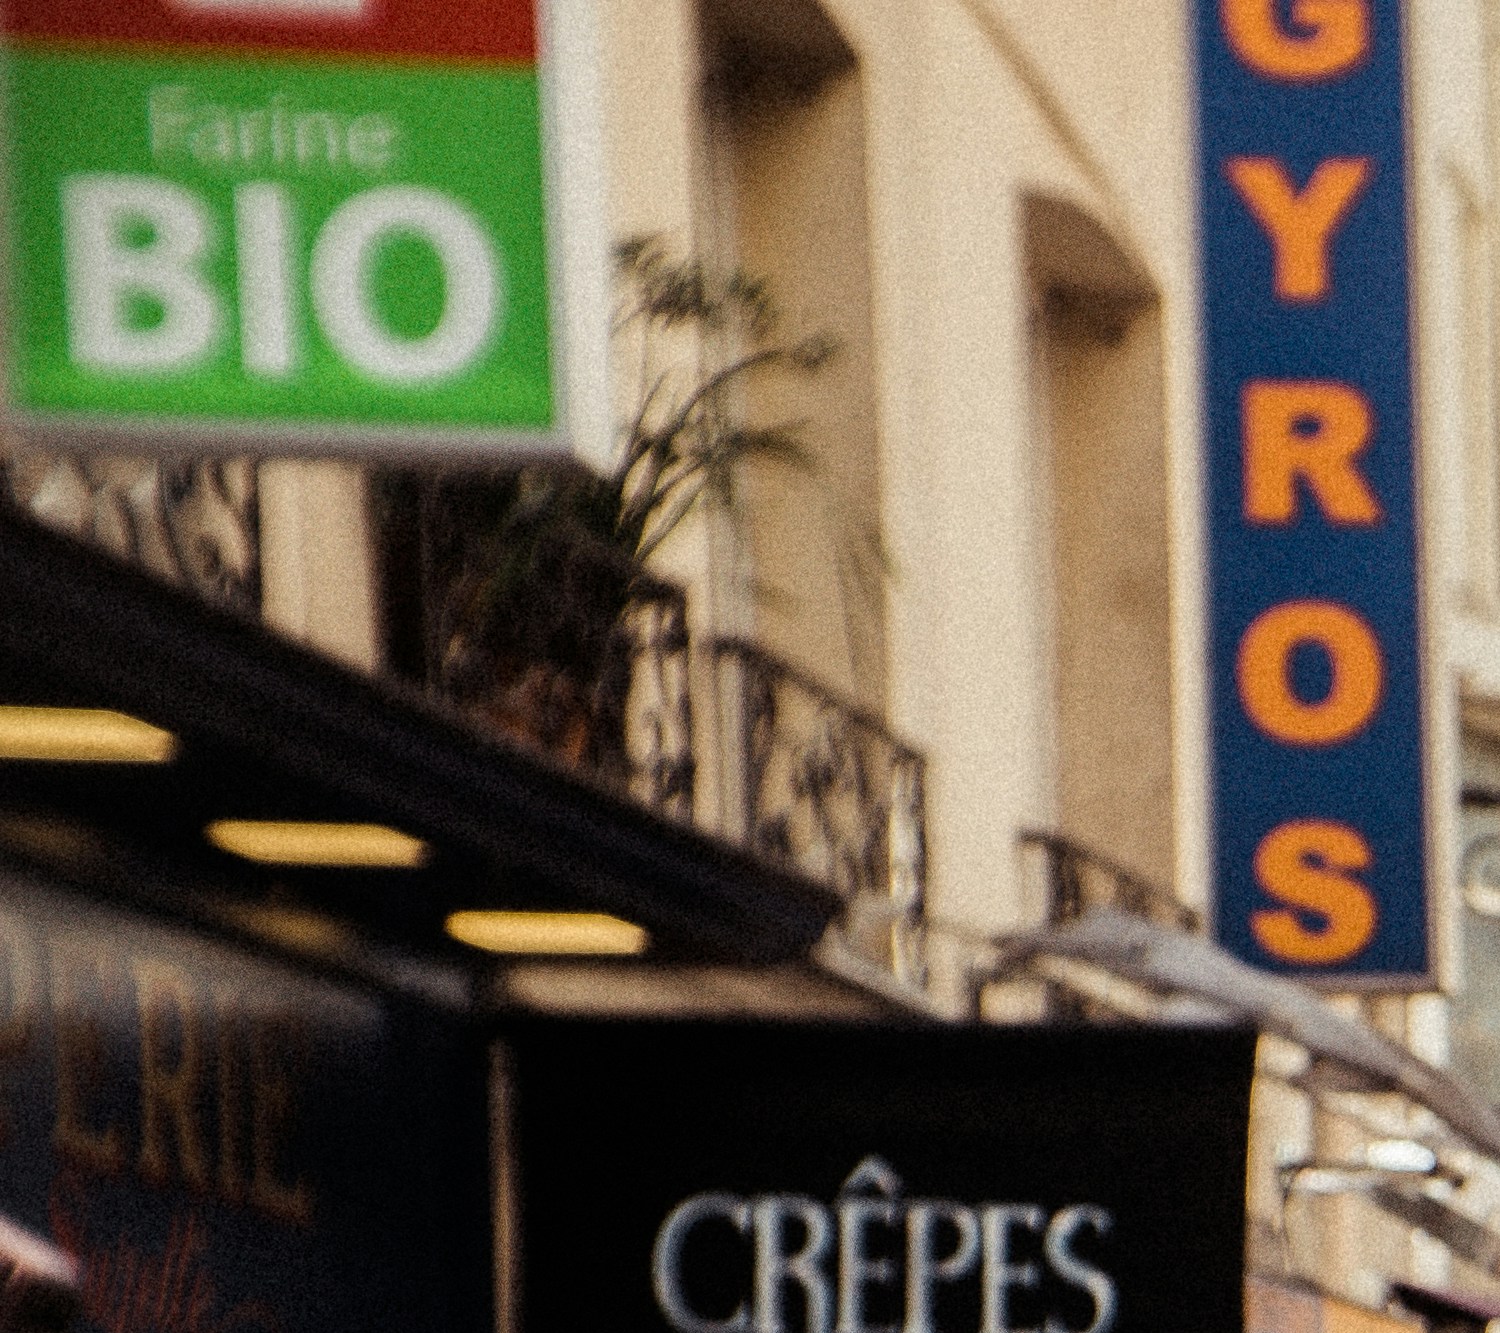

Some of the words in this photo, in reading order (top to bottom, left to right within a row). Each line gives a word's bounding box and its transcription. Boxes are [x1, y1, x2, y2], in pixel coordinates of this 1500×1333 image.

[146, 86, 402, 168] Farine
[60, 174, 505, 389] BIO
[1220, 0, 1386, 963] GYROS
